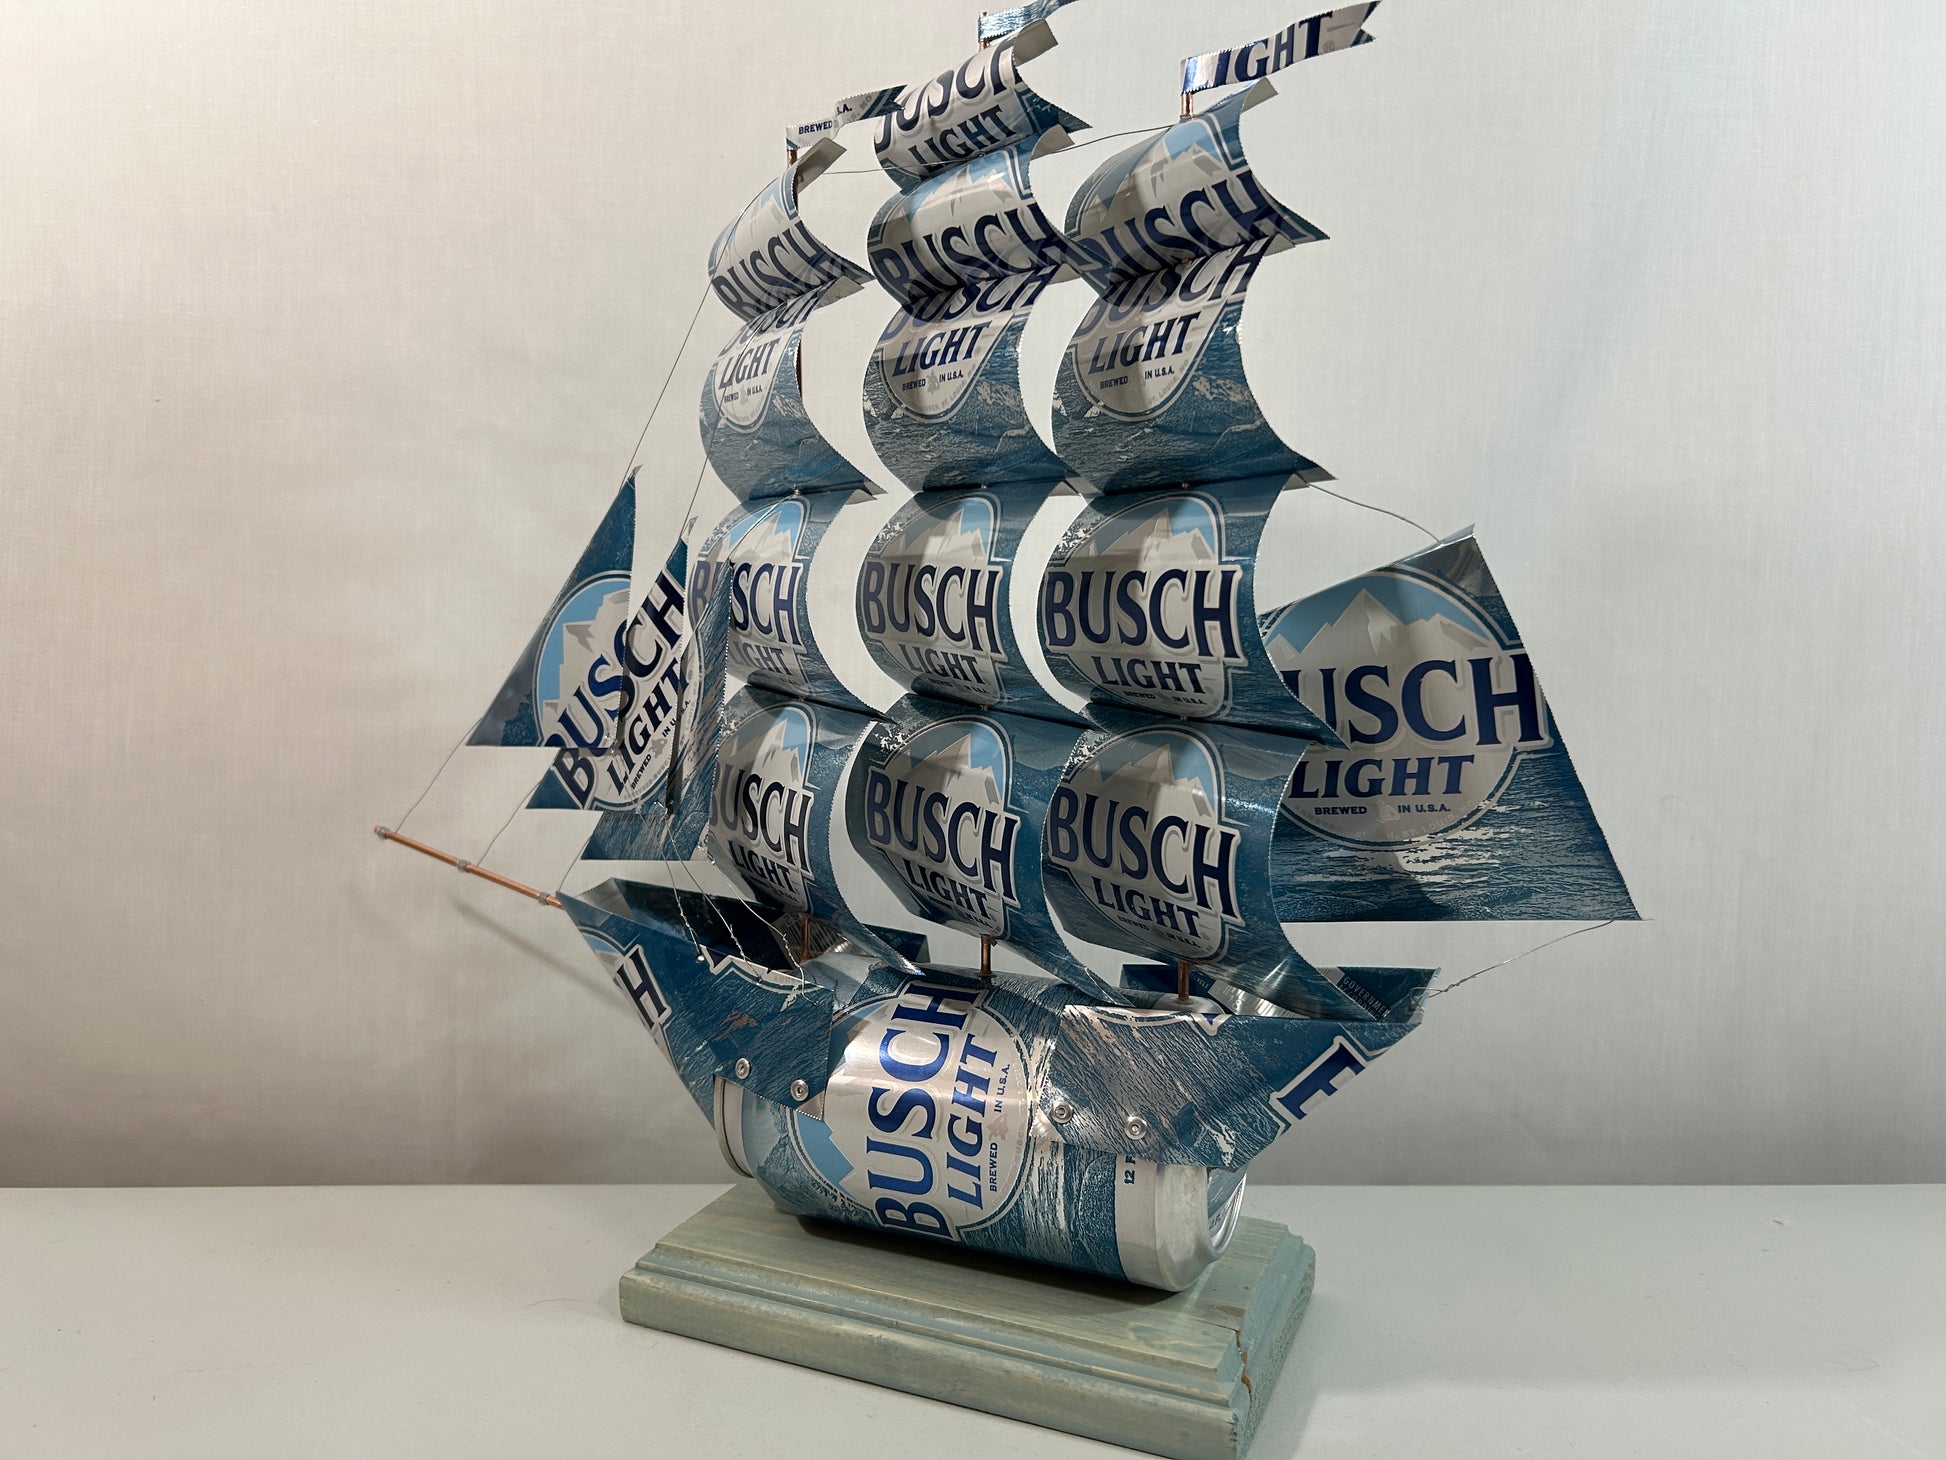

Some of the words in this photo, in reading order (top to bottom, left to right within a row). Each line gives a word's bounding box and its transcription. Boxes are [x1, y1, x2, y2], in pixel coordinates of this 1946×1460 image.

[799, 120, 833, 135] BREWED
[908, 105, 1016, 174] LIGHT
[711, 220, 863, 321] BUSCH
[869, 203, 1091, 305] BUSCH
[718, 337, 781, 389] LIGHT
[891, 321, 993, 377] LIGHT
[1088, 311, 1202, 375] LIGHT
[902, 379, 926, 391] BREWED
[1100, 376, 1129, 389] BREWED
[1144, 370, 1153, 380] IN
[1155, 366, 1175, 378] U.S.A.
[865, 561, 1002, 654] BUSCH
[1048, 568, 1241, 659] BUSCH
[900, 643, 987, 685] LIGHT
[1090, 655, 1207, 695] LIGHT
[607, 658, 686, 796] LIGHT
[630, 753, 652, 790] BREWED
[1287, 754, 1475, 799] LIGHT
[868, 769, 1019, 902] BUSCH
[1314, 805, 1367, 816] BREWED
[1398, 804, 1411, 813] IN
[1415, 803, 1451, 813] U.S.A.
[727, 839, 797, 894] LIGHT
[1050, 786, 1239, 919] BUSCH
[903, 859, 990, 919] LIGHT
[1091, 876, 1202, 939] LIGHT
[994, 1100, 1003, 1113] IN
[996, 1064, 1011, 1096] U.S.A.
[867, 980, 989, 1240] BUSCH
[947, 1033, 998, 1210] LIGHT
[989, 1142, 998, 1193] BREWED
[1124, 1169, 1136, 1186] 12
